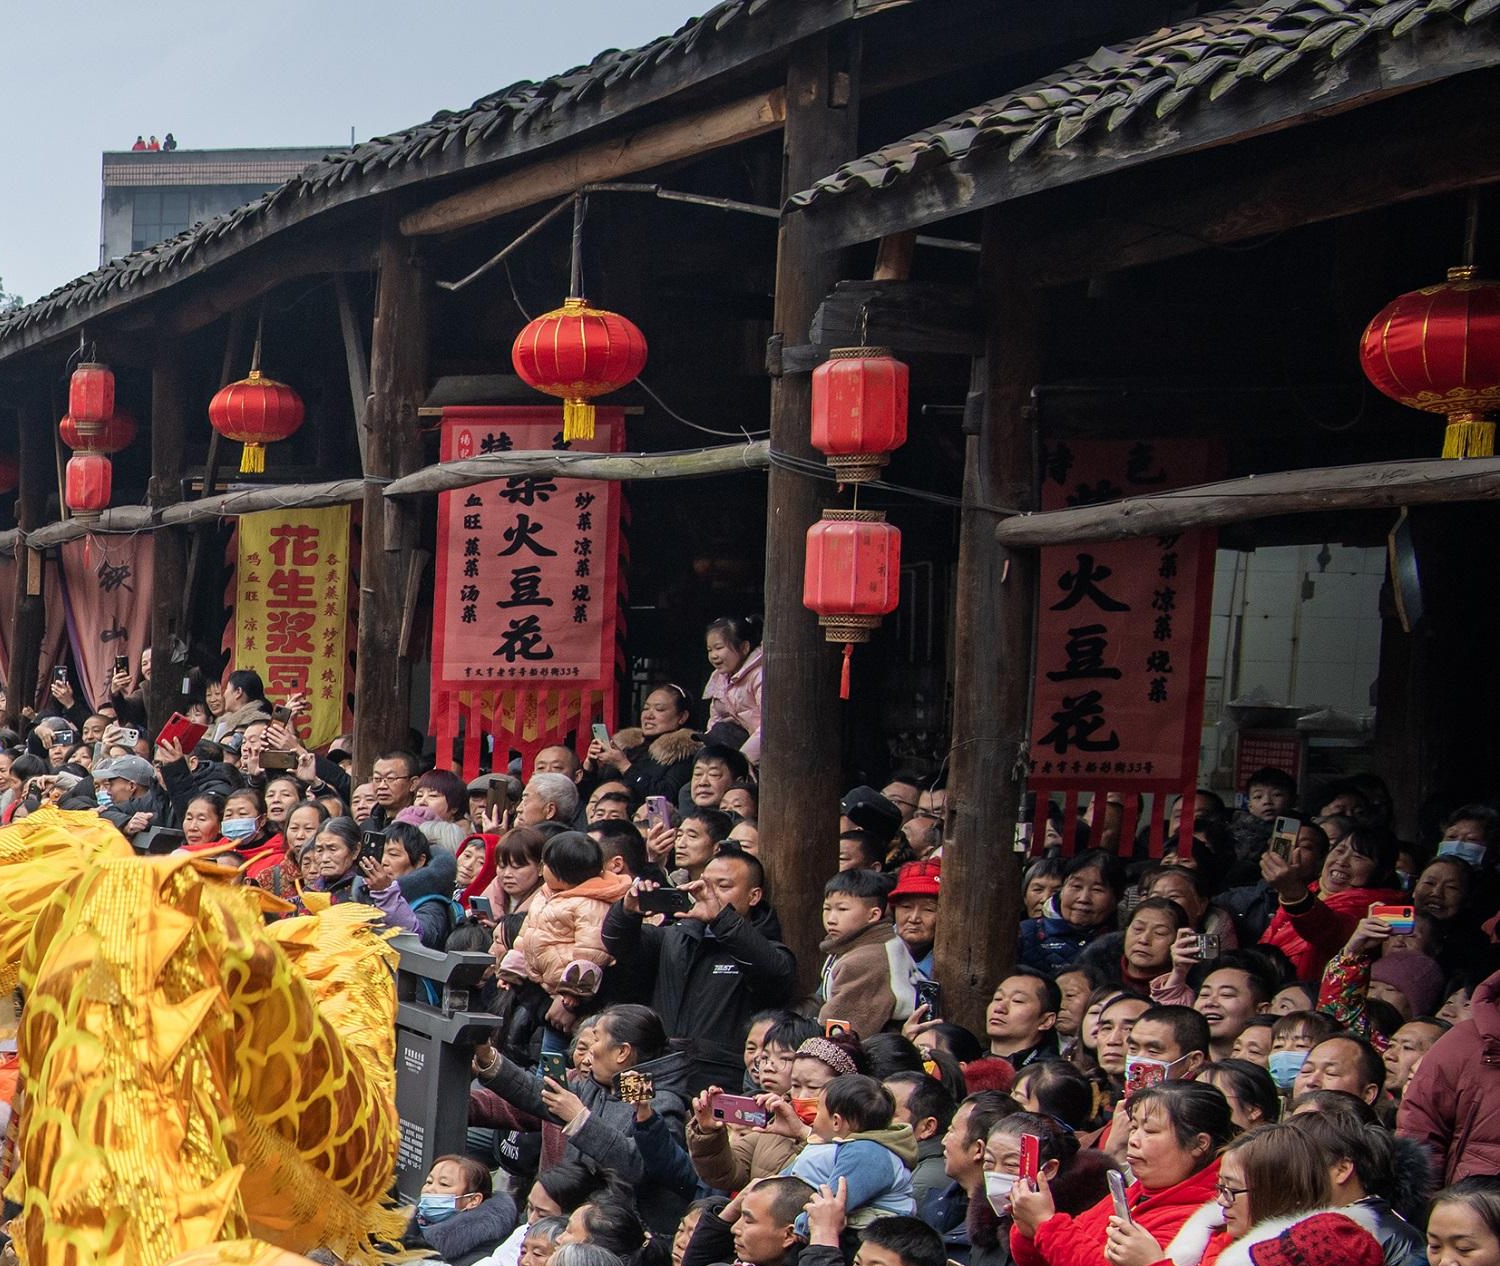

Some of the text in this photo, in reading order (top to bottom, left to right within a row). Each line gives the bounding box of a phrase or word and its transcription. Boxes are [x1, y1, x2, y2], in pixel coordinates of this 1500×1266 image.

[571, 492, 596, 624] 炒菜 凉菜 烧菜
